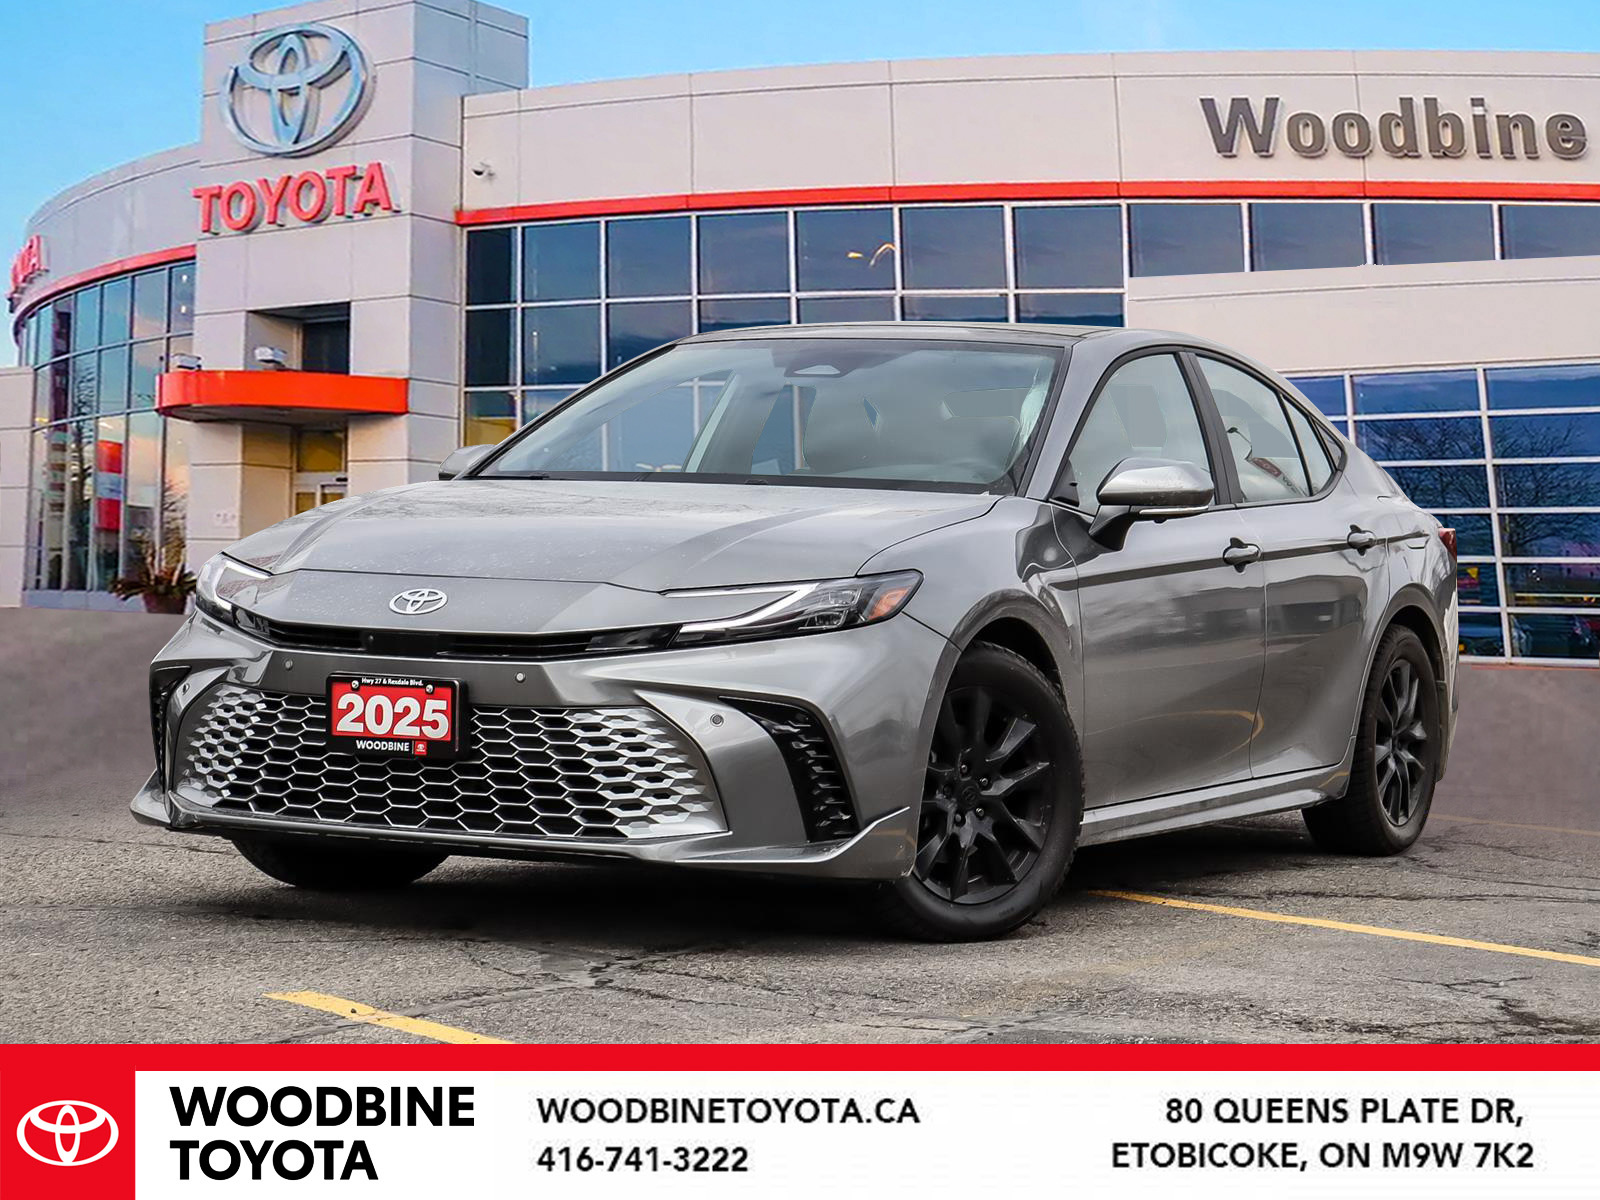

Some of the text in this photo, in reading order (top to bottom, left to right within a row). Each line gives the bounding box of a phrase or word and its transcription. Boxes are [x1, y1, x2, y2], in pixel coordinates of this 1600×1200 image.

[1199, 96, 1589, 160] Woodbine
[191, 161, 396, 235] TOYOTA
[336, 693, 449, 739] 2025
[356, 740, 410, 752] WOODBINE
